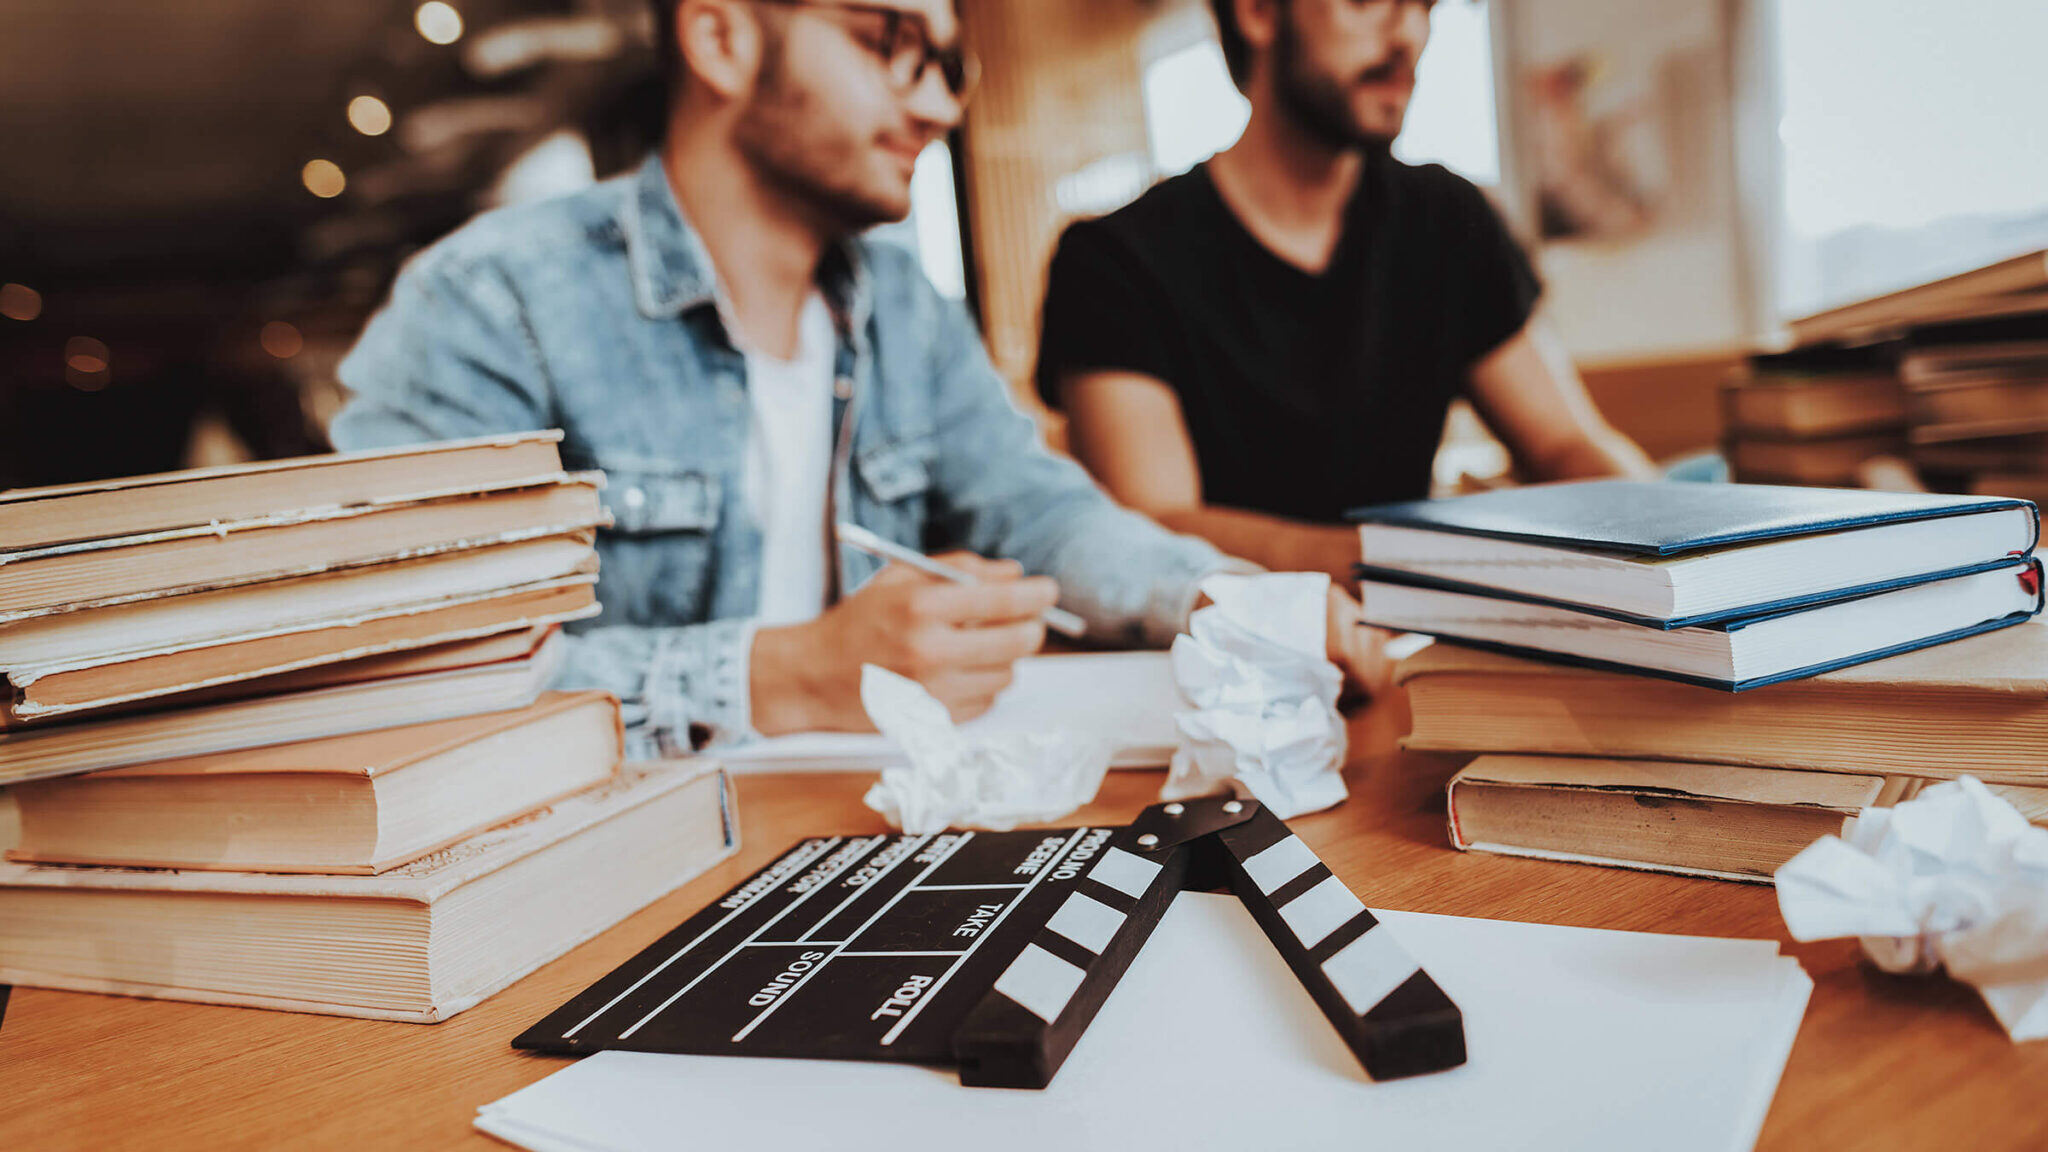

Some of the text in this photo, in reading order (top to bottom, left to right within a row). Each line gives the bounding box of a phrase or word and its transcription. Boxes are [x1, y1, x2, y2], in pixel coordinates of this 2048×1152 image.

[719, 839, 826, 910] CAMERAMAN
[786, 838, 872, 894] DIRECTOR
[1013, 837, 1066, 875] SCENE
[952, 903, 1004, 938] TAKE
[747, 950, 825, 1008] SOUND
[870, 974, 934, 1022] ROLL
